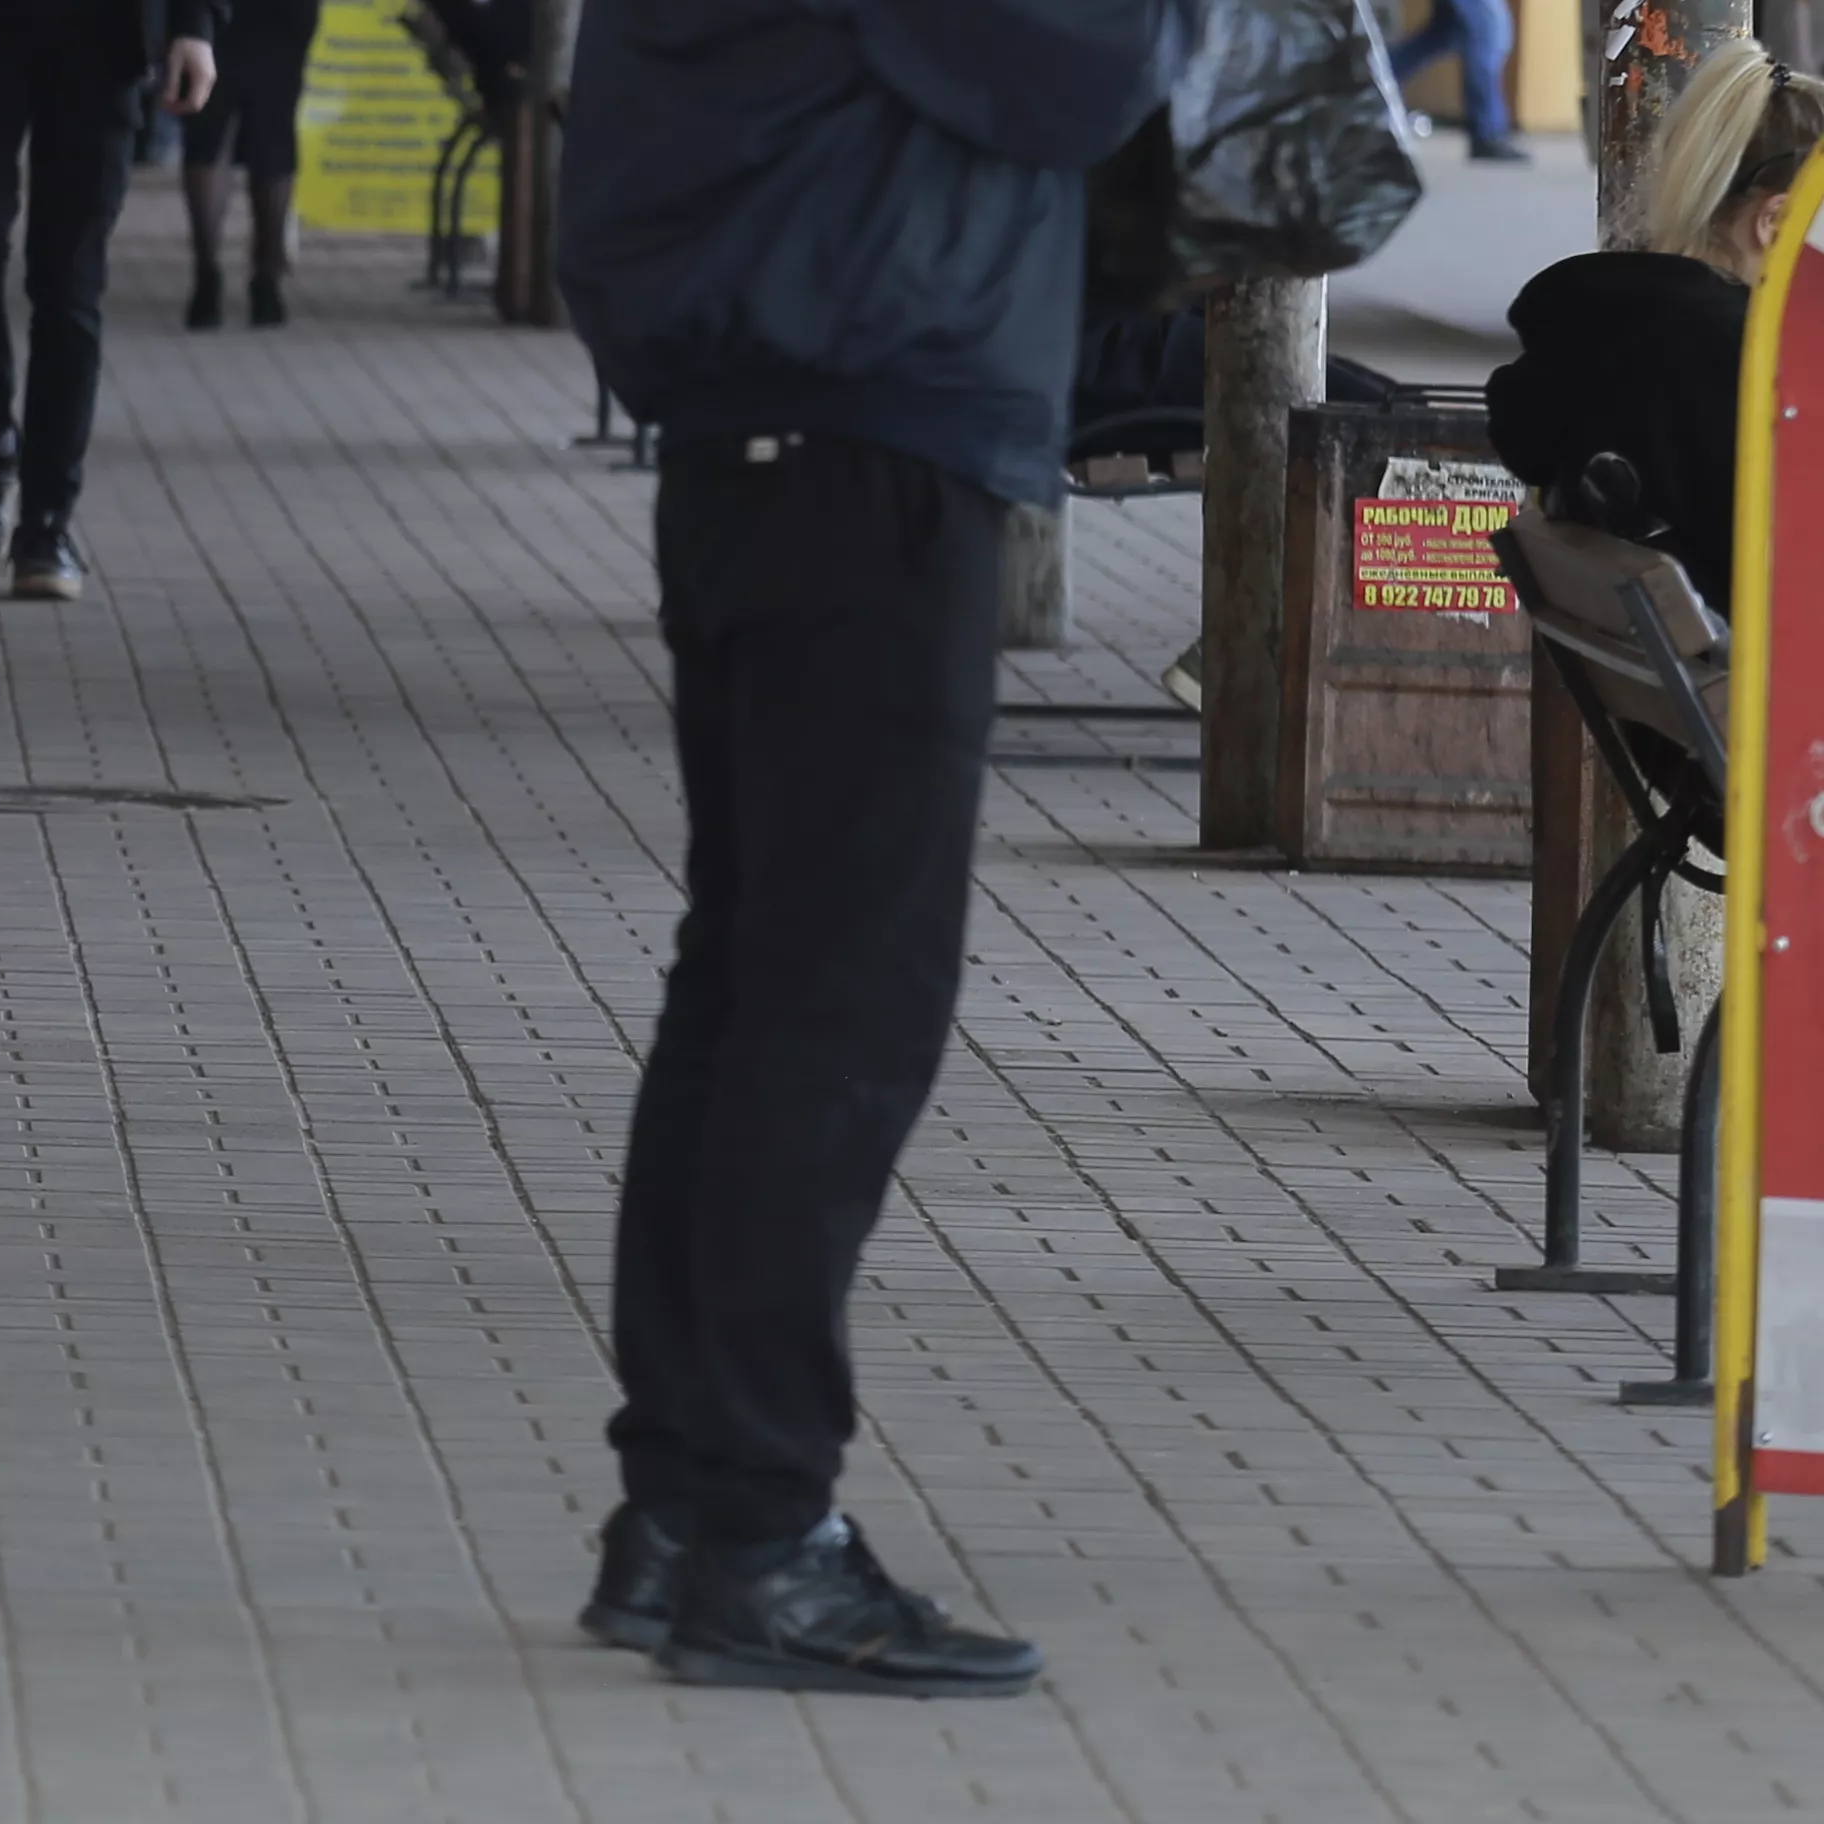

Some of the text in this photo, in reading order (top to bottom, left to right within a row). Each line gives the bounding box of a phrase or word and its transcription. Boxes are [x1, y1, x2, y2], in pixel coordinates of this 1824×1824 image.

[1464, 487, 1516, 501] БРИГАДА
[1362, 504, 1510, 535] РАБОЧИЙ ДОМ
[1364, 584, 1506, 607] 8 922 747 79 78
